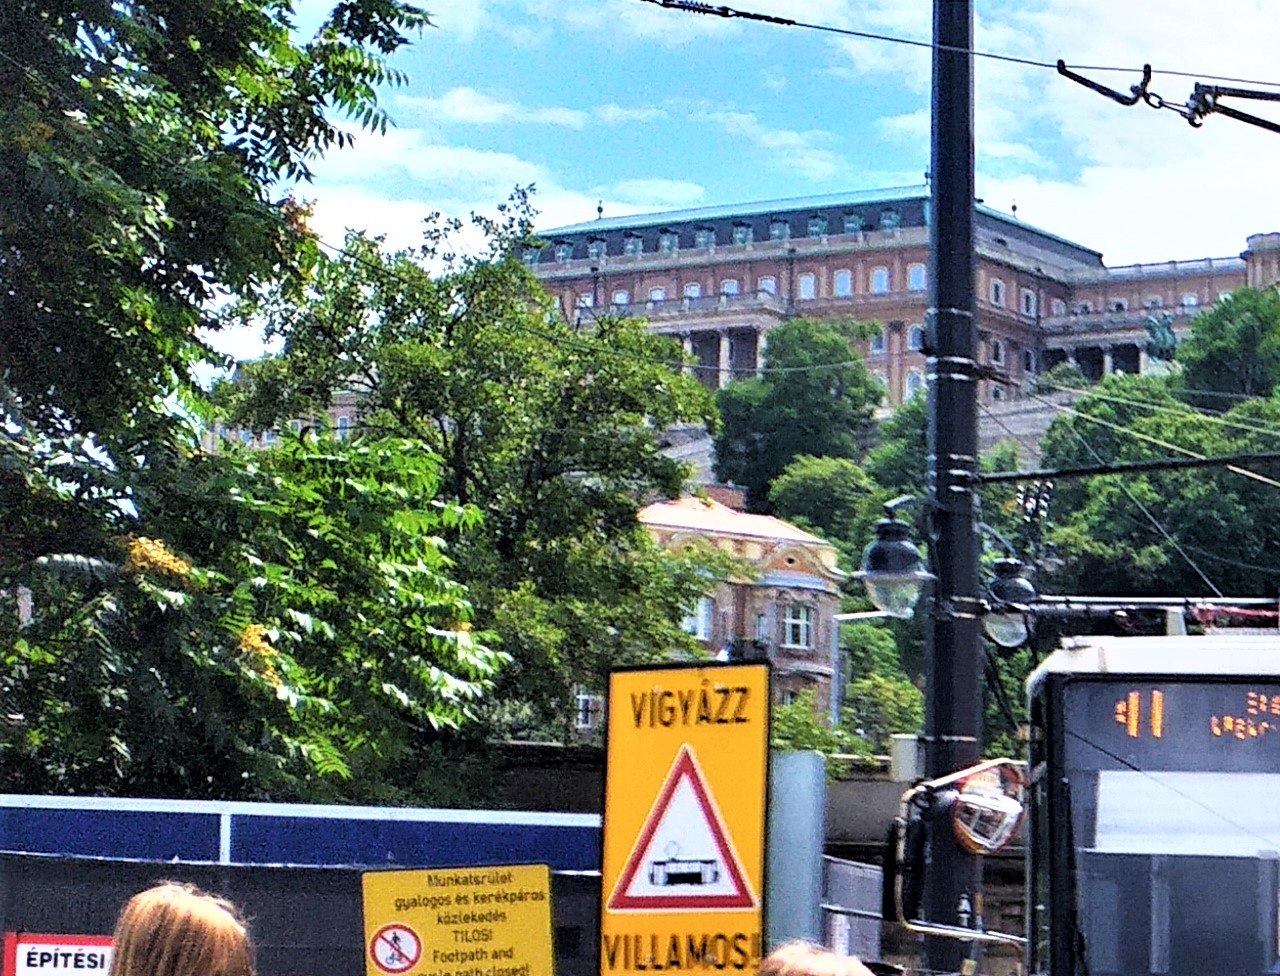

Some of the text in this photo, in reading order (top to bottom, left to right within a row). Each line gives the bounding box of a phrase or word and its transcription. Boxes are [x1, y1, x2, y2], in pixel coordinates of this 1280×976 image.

[630, 678, 751, 728] VIGYÁZZ
[394, 895, 452, 911] gyalogos
[26, 947, 106, 969] ÉPÍTÉSI
[432, 946, 514, 964] Footpath and
